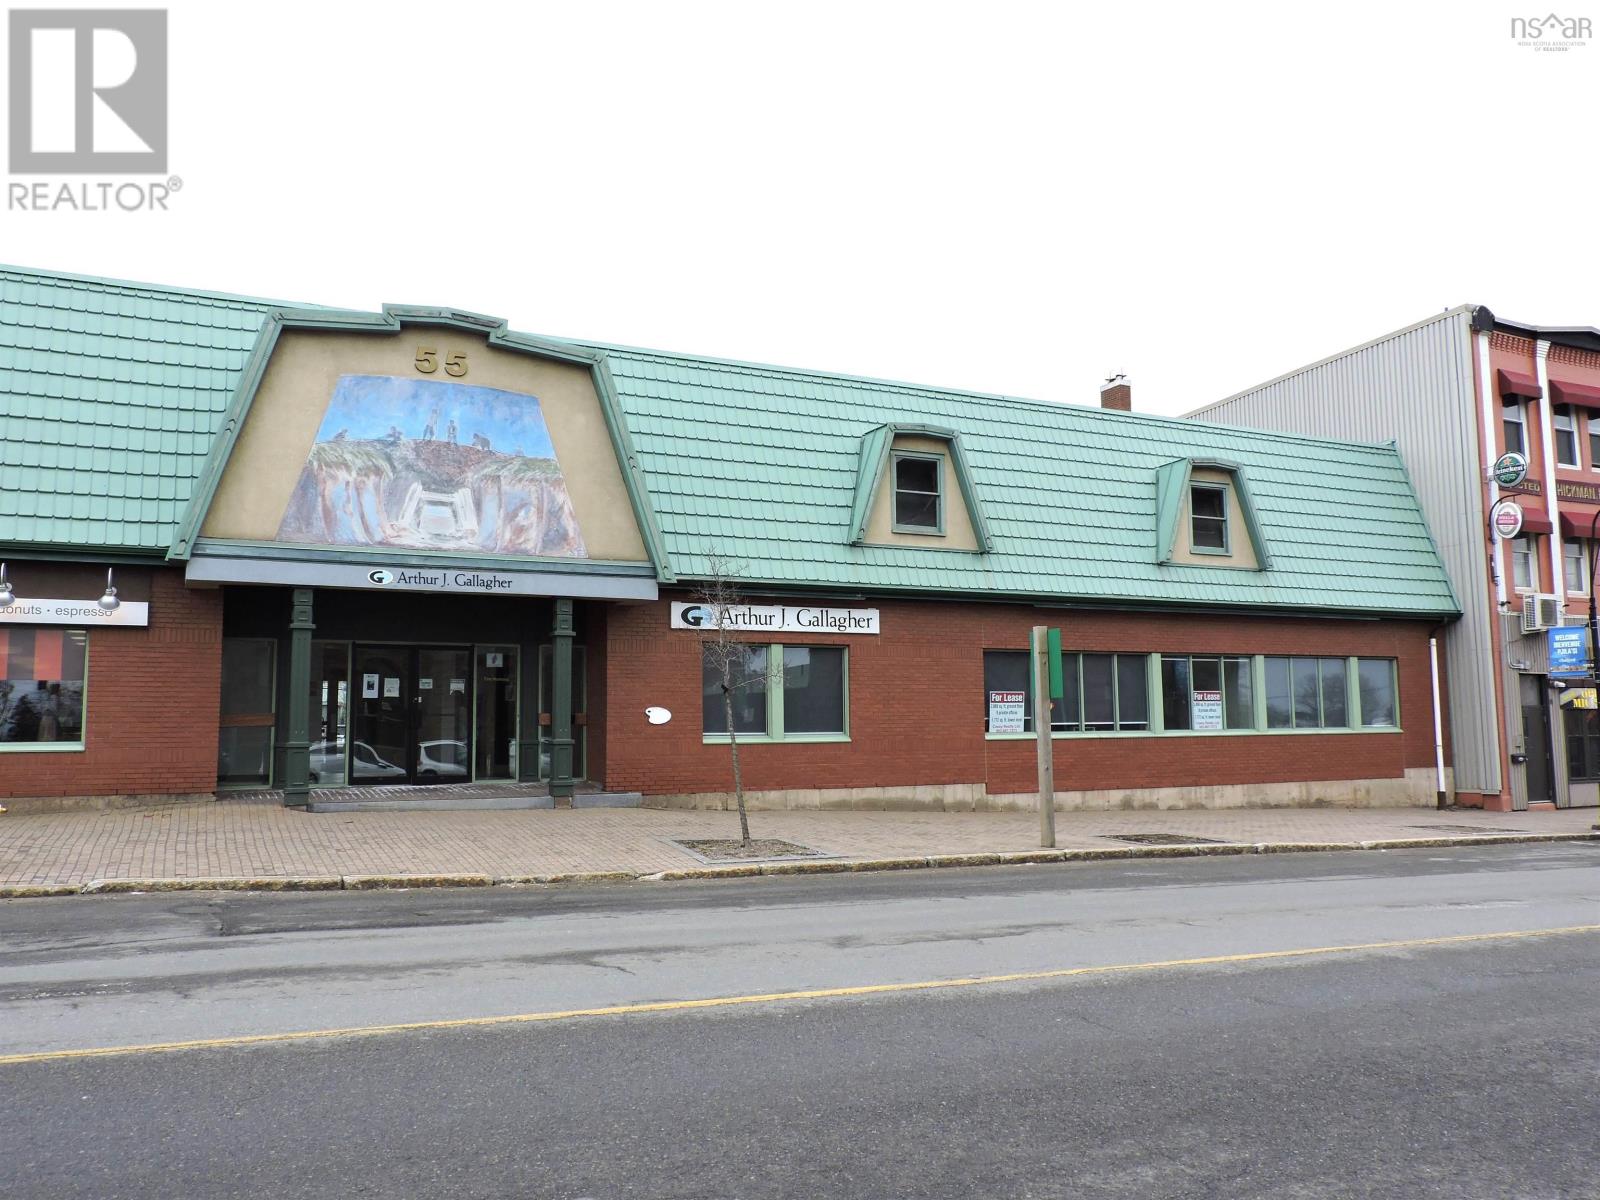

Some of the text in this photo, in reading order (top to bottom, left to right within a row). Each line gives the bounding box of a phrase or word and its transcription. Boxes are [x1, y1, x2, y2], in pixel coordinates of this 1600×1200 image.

[414, 345, 469, 377] 55
[397, 571, 439, 585] Arthur
[440, 573, 450, 588] J.
[454, 573, 513, 590] Gallagher
[55, 607, 113, 618] espresso
[721, 607, 776, 626] Arthur
[778, 608, 790, 629] J.
[796, 608, 873, 631] Gallagher
[1554, 633, 1580, 641] WELCOME
[1194, 692, 1220, 701] For Lease
